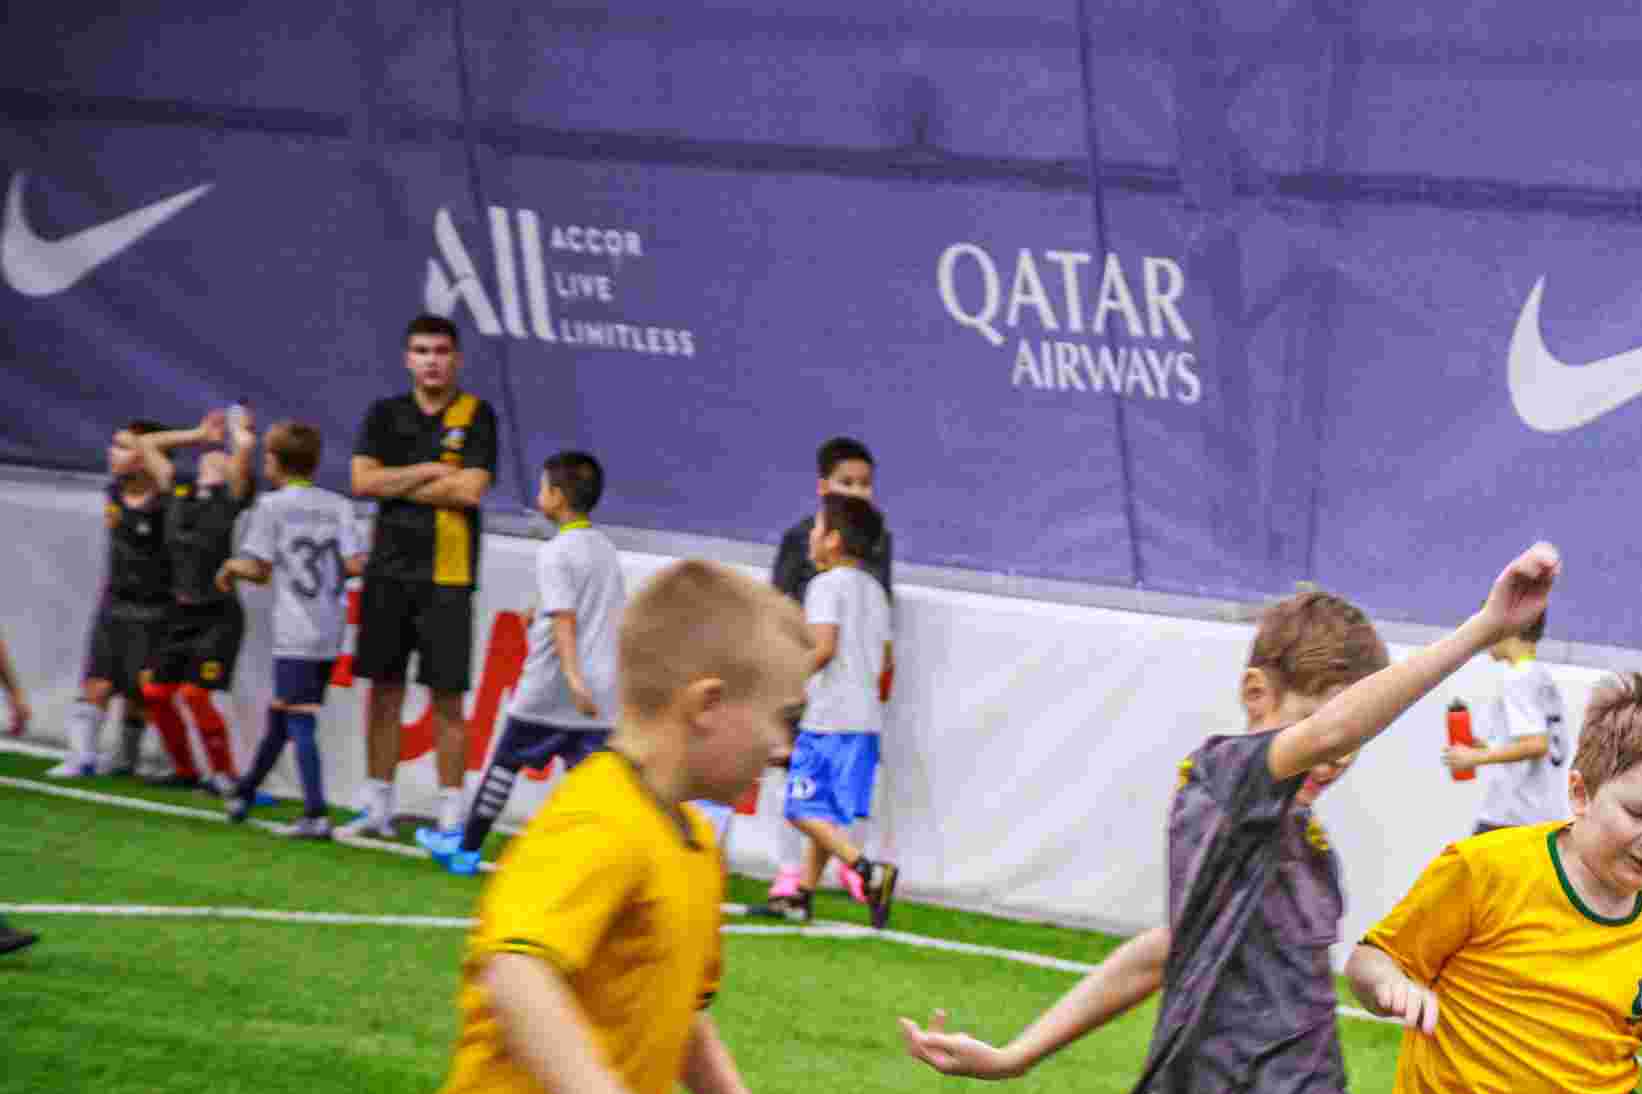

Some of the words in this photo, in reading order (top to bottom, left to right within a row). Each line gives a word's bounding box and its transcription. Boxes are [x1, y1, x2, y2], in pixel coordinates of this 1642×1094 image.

[551, 224, 643, 256] ACCOR
[553, 271, 614, 301] LIVE
[937, 241, 1193, 346] QATAR
[559, 319, 696, 356] LIMITLESS
[1012, 338, 1201, 405] AIRWAYS
